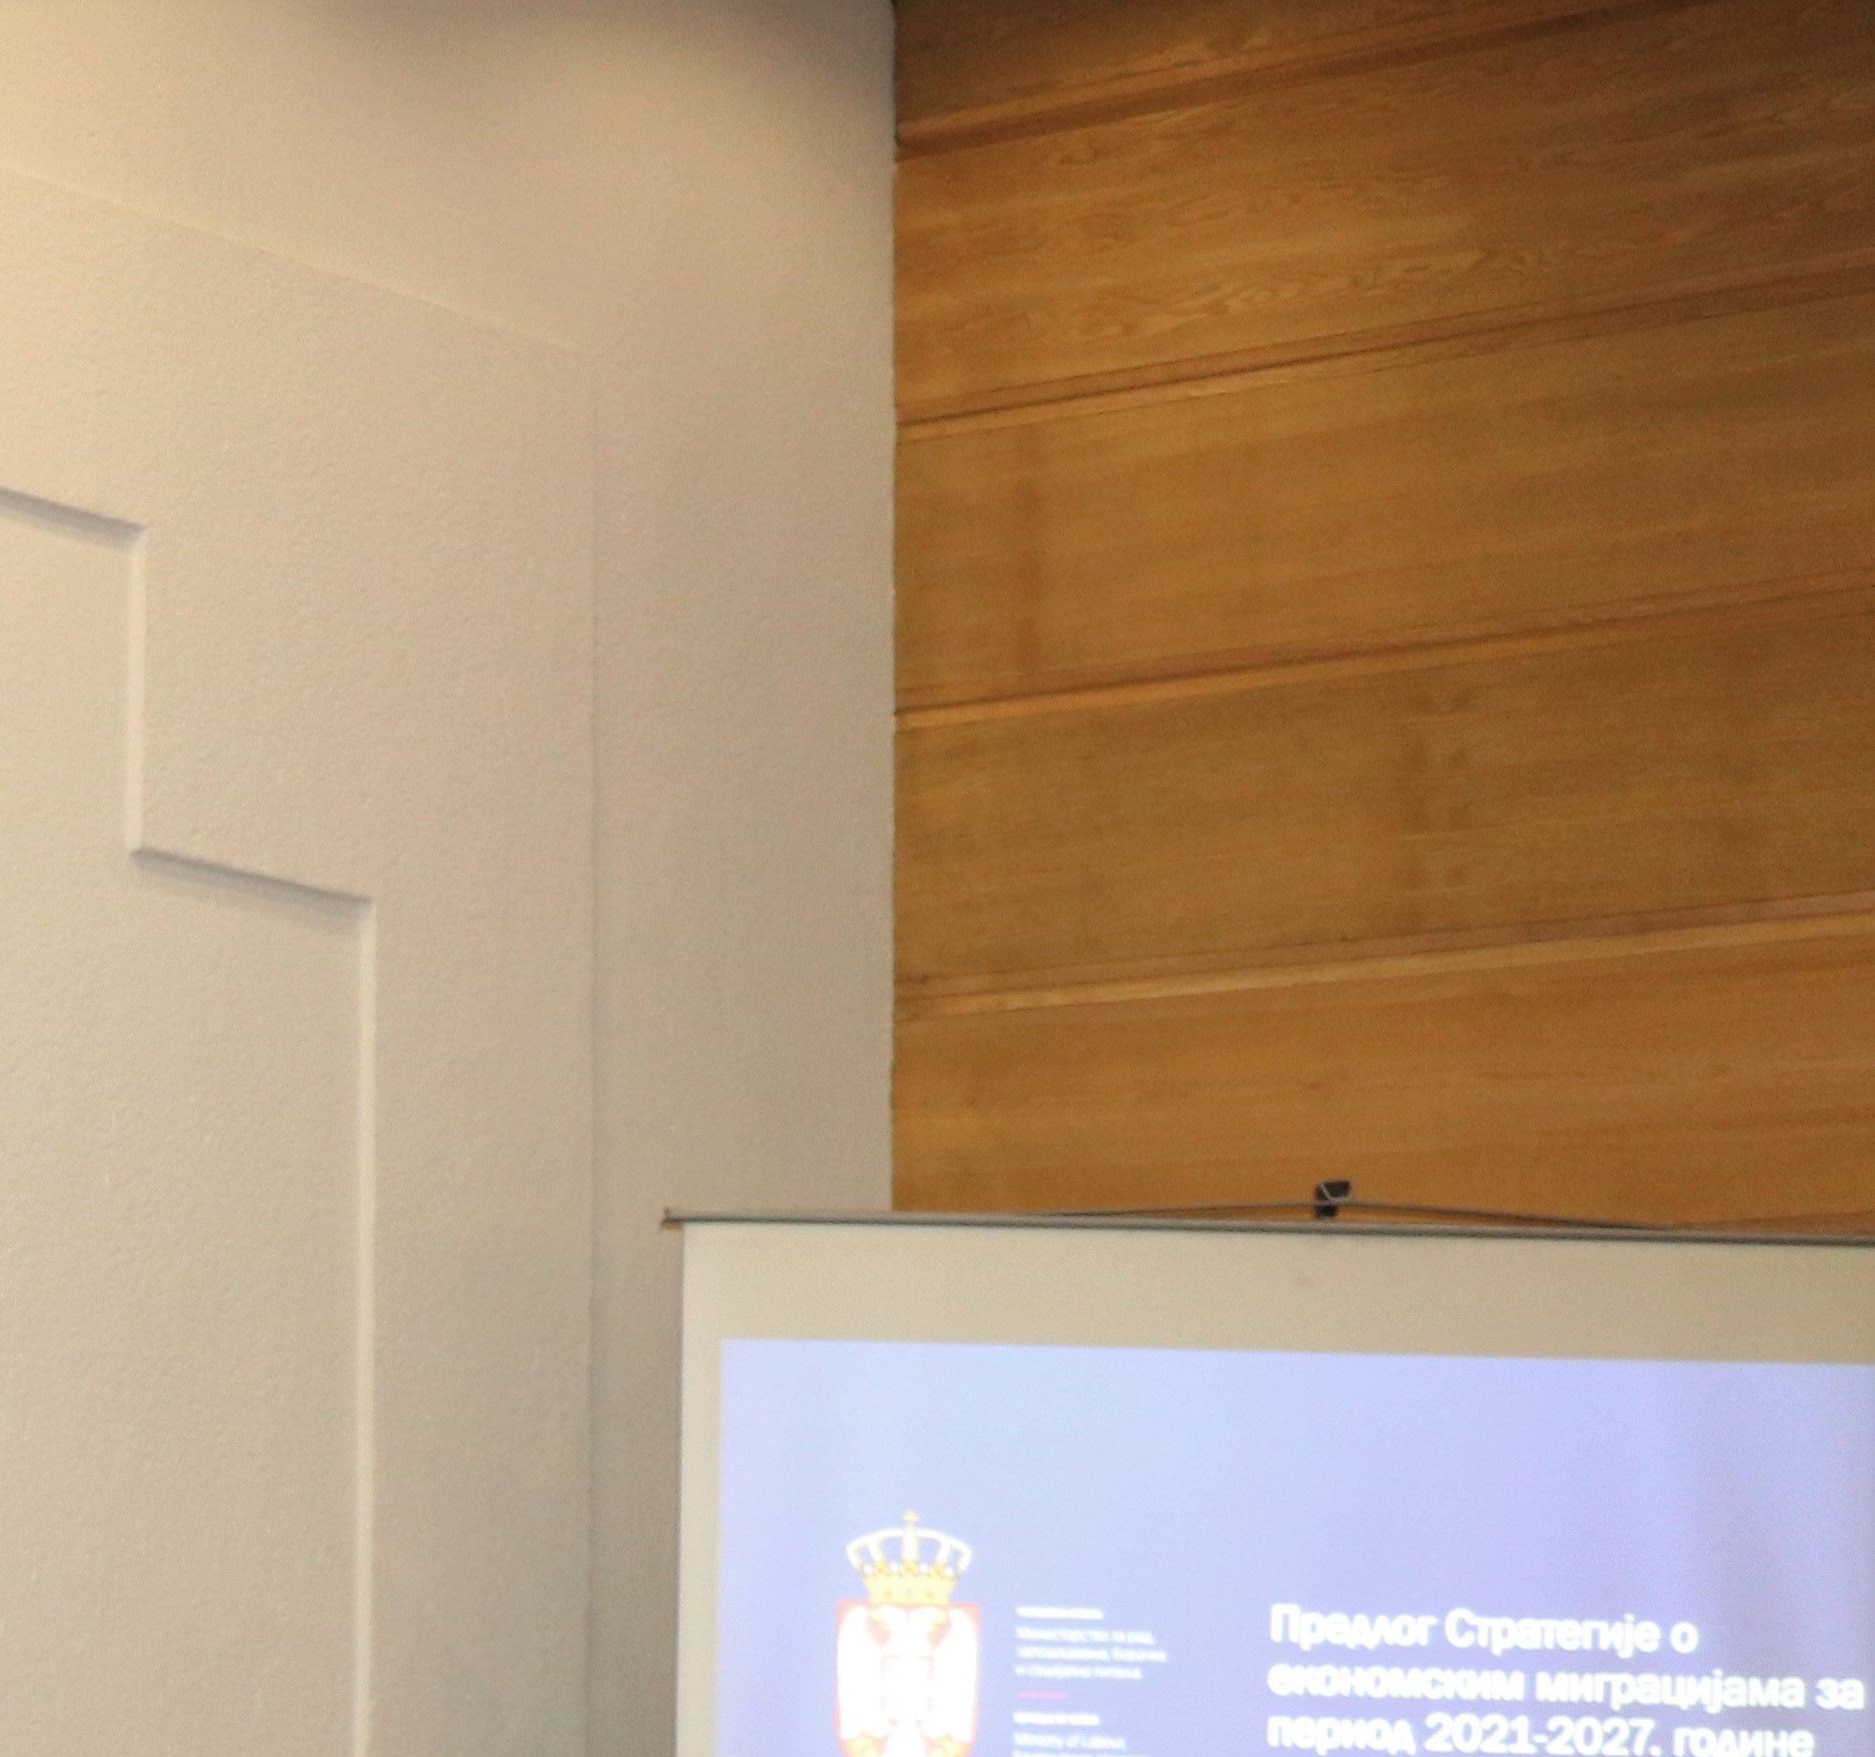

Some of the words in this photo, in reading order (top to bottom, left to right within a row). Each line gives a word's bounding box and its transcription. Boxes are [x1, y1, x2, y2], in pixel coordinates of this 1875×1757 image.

[1270, 1603, 1438, 1651] Предлог
[1445, 1608, 1661, 1659] Стратегије
[1670, 1622, 1699, 1653] о
[1267, 1663, 1525, 1700] економским
[1535, 1668, 1806, 1714] миграцијама
[1815, 1677, 1866, 1710] за
[1267, 1715, 1417, 1757] период
[1424, 1712, 1662, 1757] 2021-2027.
